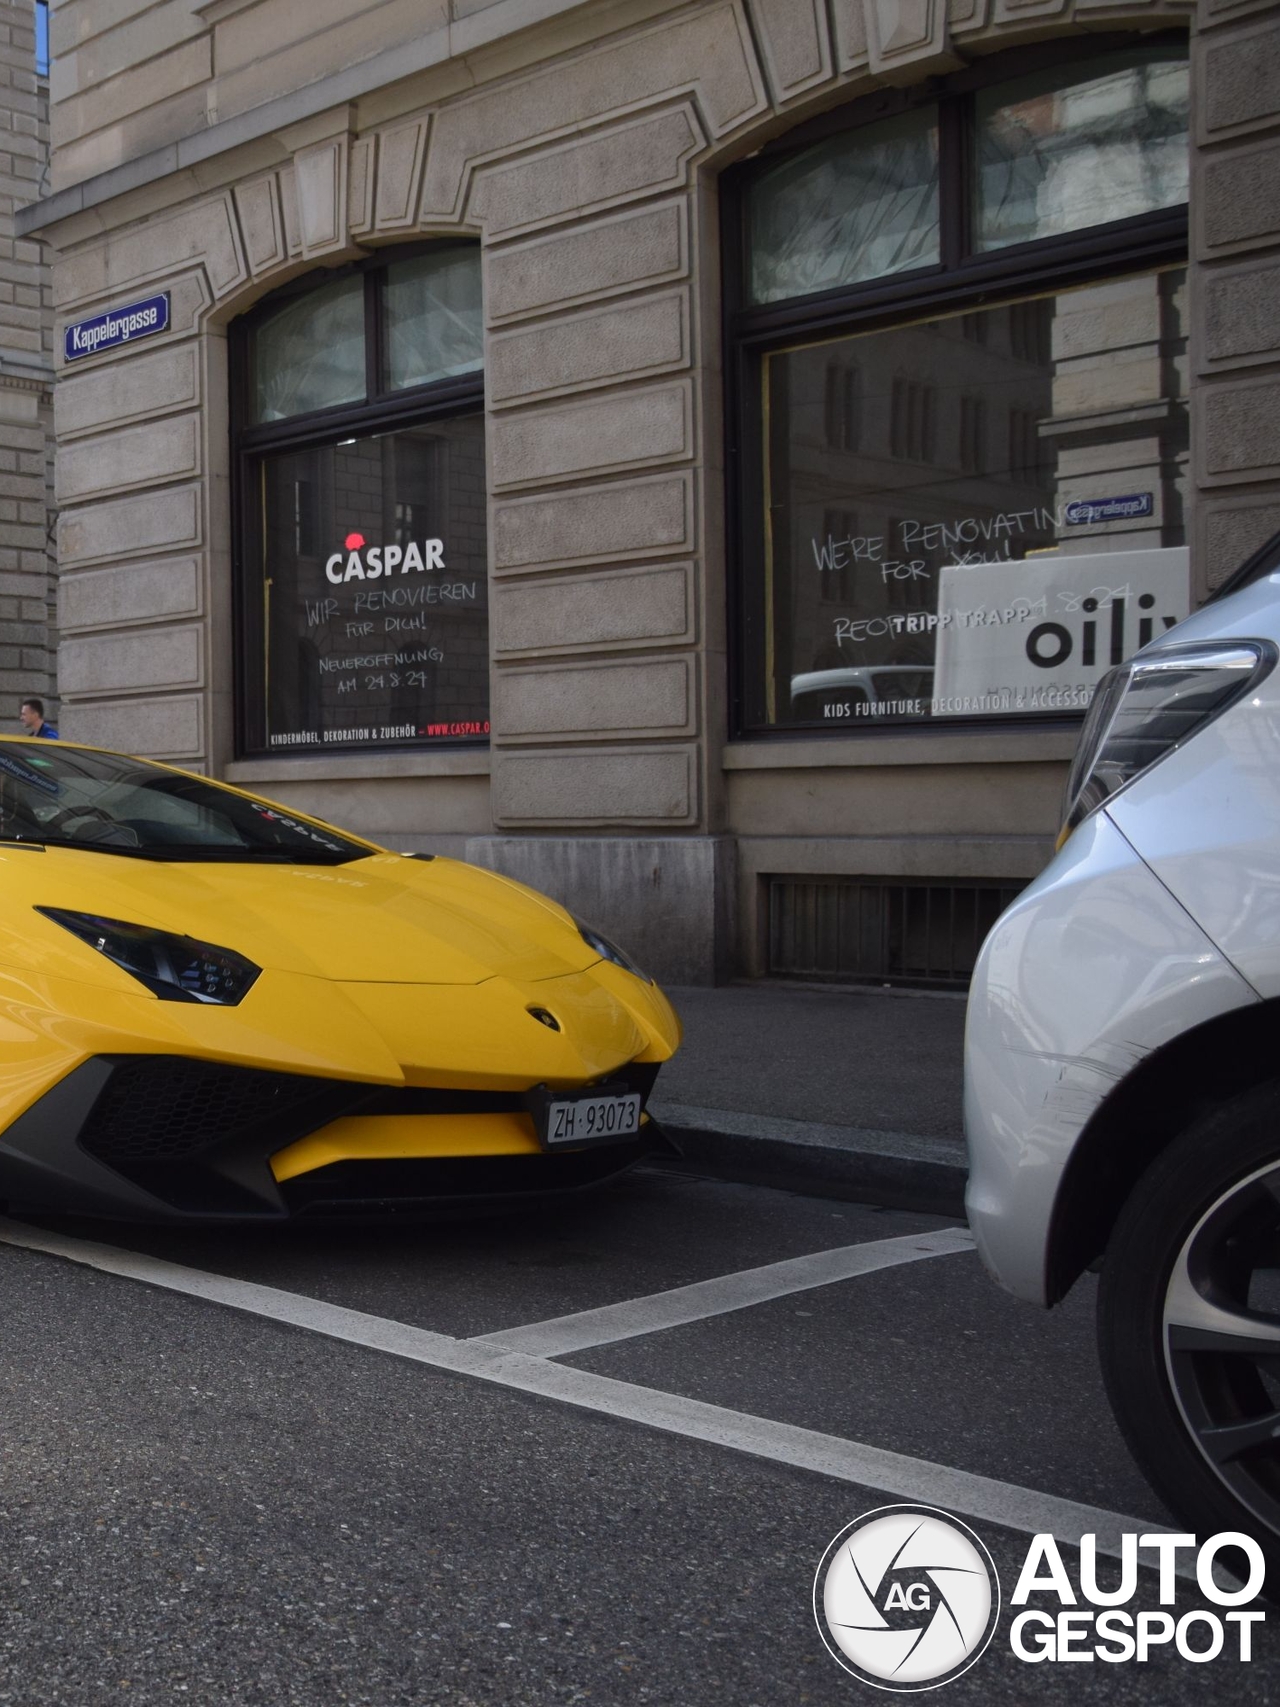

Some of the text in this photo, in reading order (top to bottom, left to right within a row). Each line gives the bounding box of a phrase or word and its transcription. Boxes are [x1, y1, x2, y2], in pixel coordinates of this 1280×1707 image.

[73, 307, 158, 351] Kappelergasse
[325, 538, 446, 585] CASPAR
[812, 534, 884, 571] WE'RE
[881, 560, 930, 584] FOR
[305, 581, 477, 627] WIR RENOVIEREN
[384, 611, 427, 632] DICH!
[893, 606, 1031, 633] TRIPP TRAPP
[337, 671, 428, 694] AM 24.8.24
[824, 703, 851, 718] KIDS
[856, 699, 925, 716] FURNITURE,
[932, 694, 1010, 712] DECORATION
[1015, 694, 1026, 709] &
[270, 730, 322, 745] KINDERMÖBEL,
[324, 727, 369, 742] DEKORATION
[371, 728, 378, 740] &
[380, 723, 416, 739] ZUBEHÖR
